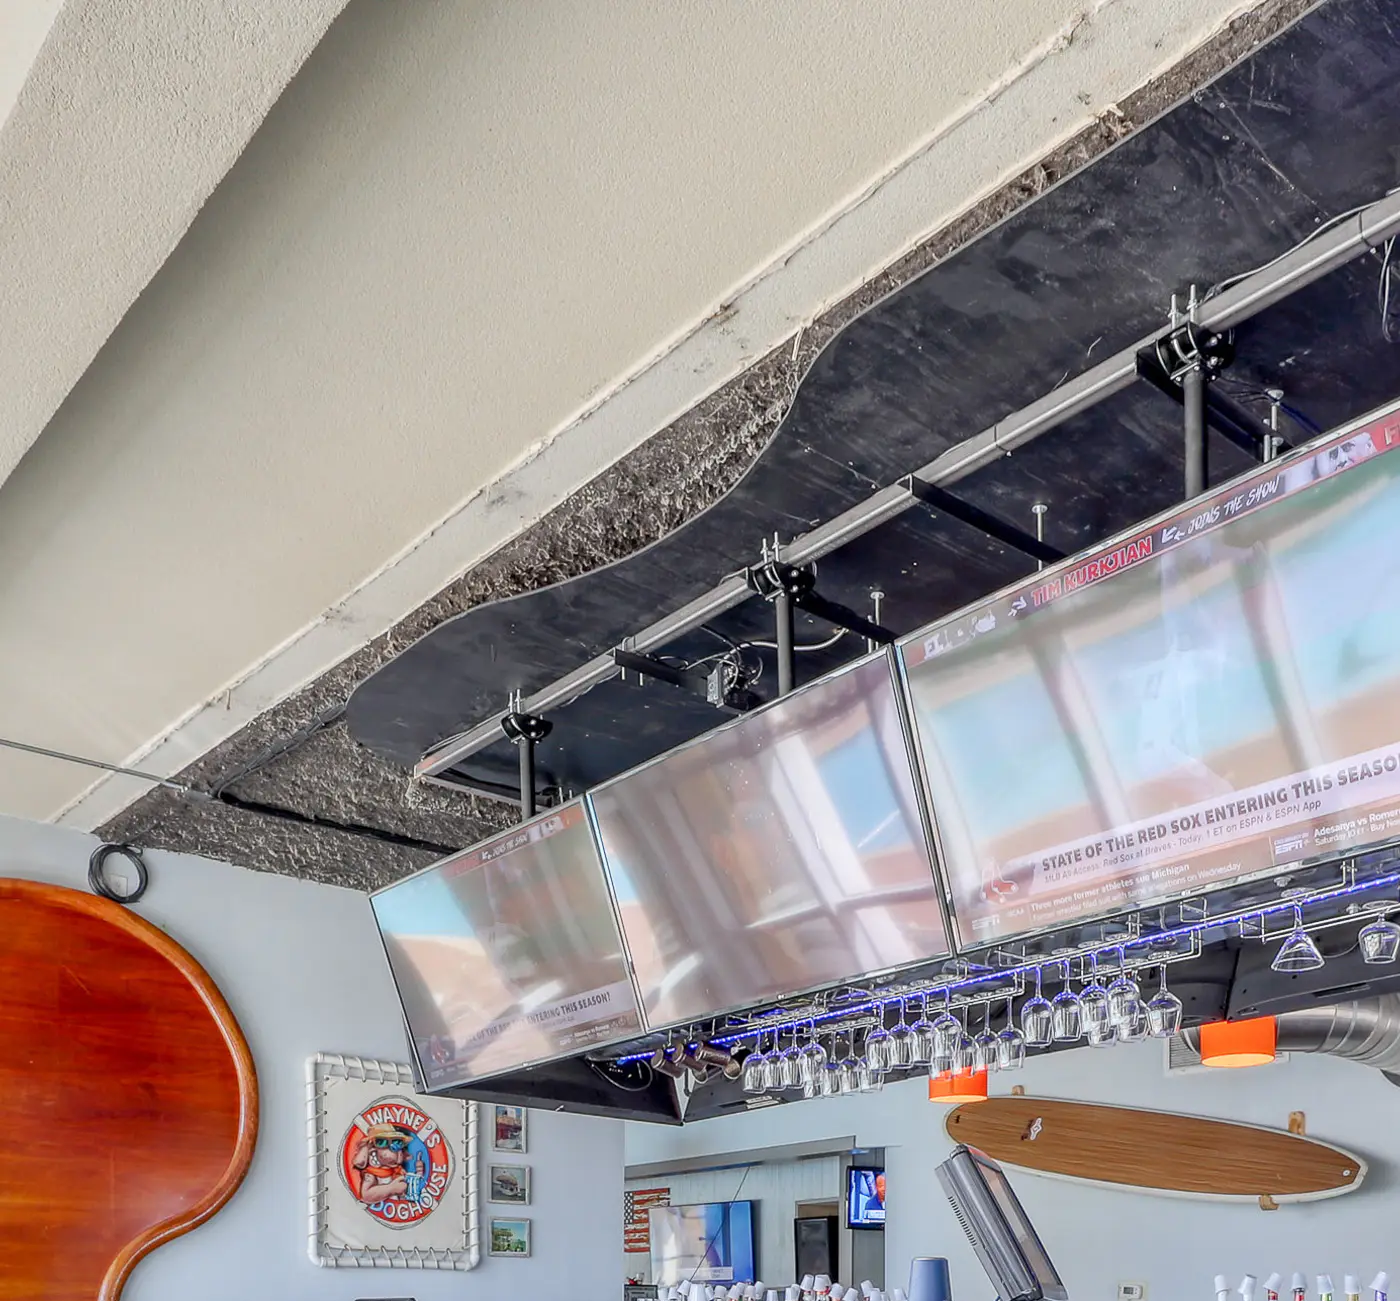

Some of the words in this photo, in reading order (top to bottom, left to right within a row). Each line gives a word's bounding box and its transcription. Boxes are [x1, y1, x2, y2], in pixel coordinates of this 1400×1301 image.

[1223, 493, 1245, 516] THE
[1246, 476, 1280, 507] SHOW
[1031, 578, 1062, 607] TIM
[1064, 535, 1153, 593] KURKJIAN
[1042, 850, 1083, 872] STATE
[1085, 841, 1103, 859] OF
[1105, 833, 1135, 853] THE
[1137, 823, 1168, 844] RED
[1170, 811, 1202, 835] SOX
[1204, 787, 1289, 825] ENTERING
[1291, 773, 1333, 799] THIS
[1337, 753, 1400, 786] SEASO
[1103, 857, 1118, 868] Red
[1213, 826, 1224, 837] ET
[1226, 824, 1237, 833] on
[1240, 817, 1264, 830] ESPN
[1266, 813, 1272, 821] &
[1275, 805, 1300, 819] ESPN
[1303, 800, 1322, 813] App
[1314, 821, 1356, 838] Adesanya
[1357, 817, 1367, 826] vs
[1053, 895, 1073, 907] more
[1073, 887, 1100, 901] former
[1102, 878, 1135, 894] athletes
[1135, 874, 1151, 884] sue
[1151, 863, 1190, 881] Michigan
[560, 1002, 577, 1016] THIS
[369, 1162, 447, 1220] DOGHOUSE
